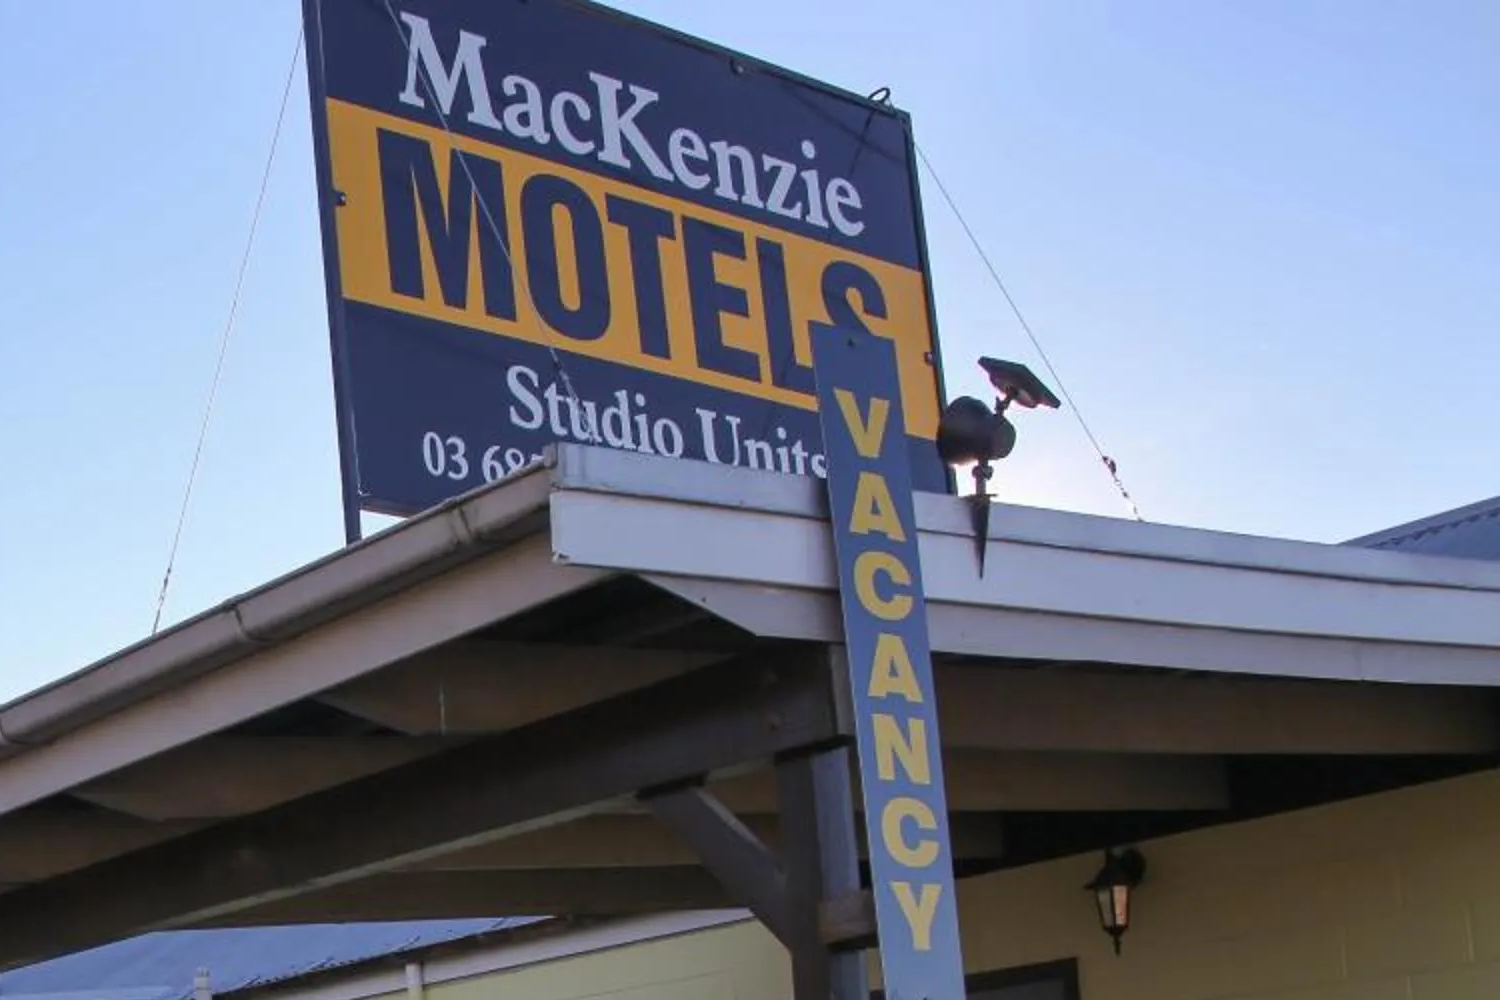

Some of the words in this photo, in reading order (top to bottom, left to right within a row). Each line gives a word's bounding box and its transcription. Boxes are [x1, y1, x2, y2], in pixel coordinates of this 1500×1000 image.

[399, 12, 865, 237] MacKenzie
[423, 431, 468, 480] 03
[506, 365, 684, 459] Studio
[832, 388, 942, 952] VACANCY
